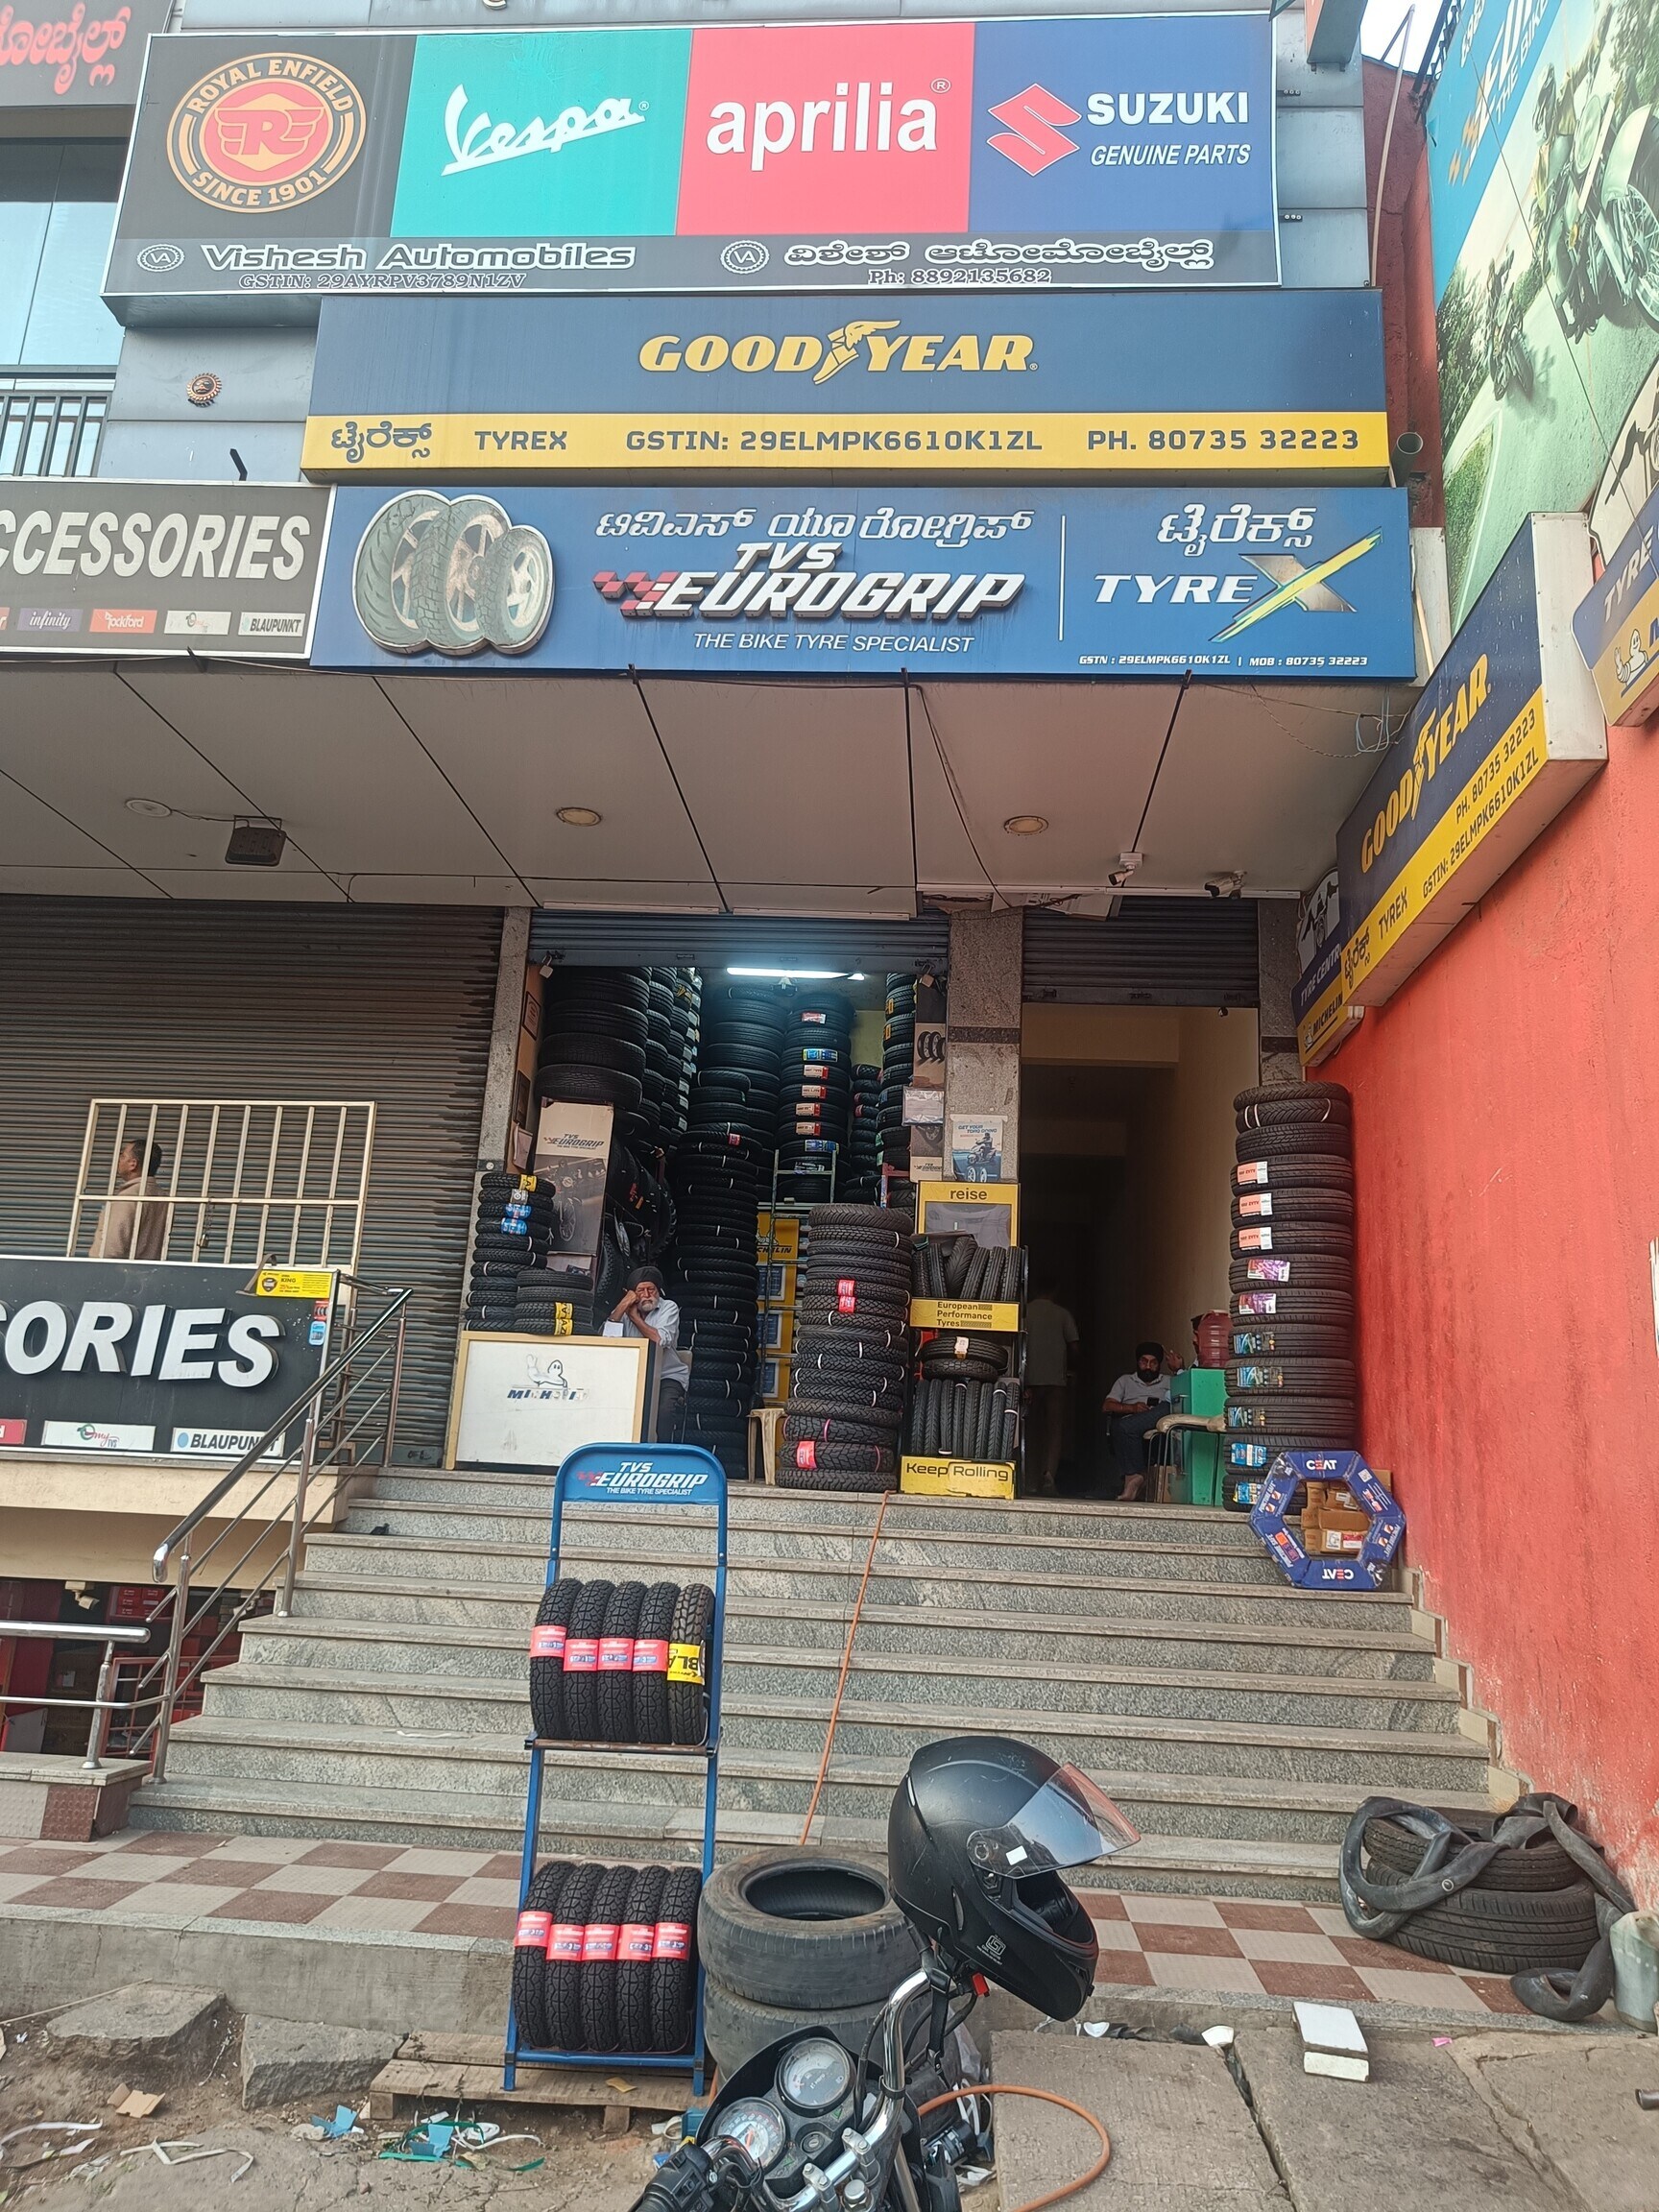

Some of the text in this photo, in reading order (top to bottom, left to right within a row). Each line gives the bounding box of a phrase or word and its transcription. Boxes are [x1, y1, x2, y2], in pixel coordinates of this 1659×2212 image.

[185, 59, 354, 114] ROYAL ENFIELD
[1495, 59, 1519, 125] THE
[1086, 91, 1248, 127] SUZUKI
[441, 84, 646, 177] Vespa
[705, 82, 938, 172] aprilia
[1090, 144, 1251, 166] GENUINE PARTS
[192, 170, 327, 206] SINCE 1901
[200, 242, 636, 271] Vishesh Automobiles
[239, 273, 526, 289] GSTIN: 29AYRPV3789N1ZV
[868, 267, 1052, 285] Ph: 8892135682
[474, 429, 1358, 451] TYREX GSTIN: 29ELMPK6610K1ZL PH. 80735 32223
[733, 541, 843, 571] TVS
[1603, 525, 1654, 623] TYRE
[654, 571, 1026, 619] EUROGRIP
[29, 610, 71, 630] infinity
[250, 618, 301, 633] BLAUPUNKT
[693, 633, 975, 653] THE BIKE TYRE SPECIALIST
[1078, 655, 1368, 666] GSTN 29ELMPK6610K1ZL MOB 80735 32223
[1361, 653, 1490, 873] GOODYEAR
[1455, 708, 1536, 825] PH. 80735 32223
[1423, 747, 1539, 899] GSTIN: 29ELMPK6610K1ZL
[1379, 886, 1408, 940] TYREX
[1300, 976, 1315, 1007] TYRE
[552, 1138, 605, 1147] EUROGRIP
[950, 1188, 988, 1200] reise
[937, 1301, 977, 1311] European
[937, 1310, 993, 1320] Performance
[937, 1319, 960, 1328] Tyres
[0, 1300, 285, 1388] ORIES
[190, 1432, 279, 1452] BLAUPUNT
[620, 1462, 654, 1473] TVS
[906, 1462, 1009, 1481] Keep Rolling
[1306, 1459, 1337, 1471] CEAT
[594, 1473, 709, 1488] EUROGRIP
[1322, 1568, 1355, 1580] CEAT
